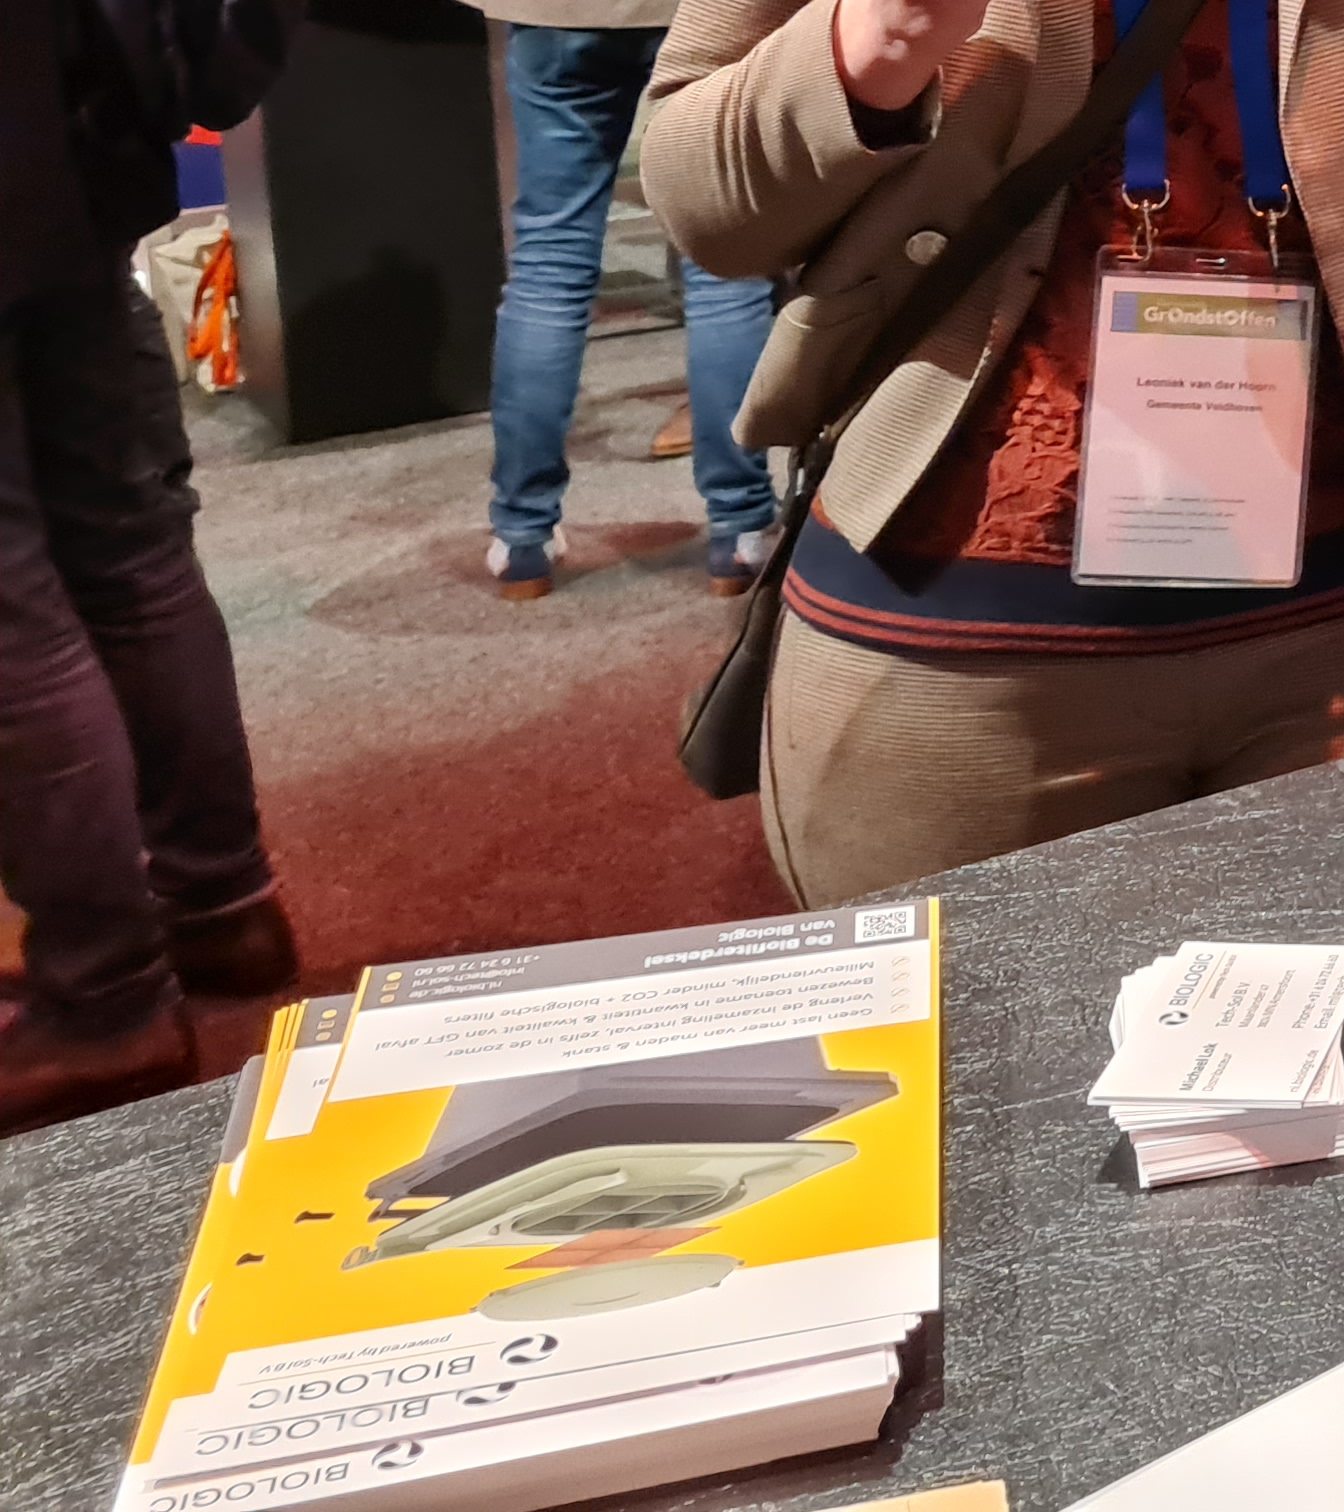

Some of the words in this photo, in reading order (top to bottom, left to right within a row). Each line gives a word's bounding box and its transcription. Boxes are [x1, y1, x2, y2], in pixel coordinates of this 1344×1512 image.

[1189, 380, 1212, 389] van
[1214, 379, 1236, 390] der
[800, 918, 836, 933] van
[717, 923, 795, 945] Biologic
[804, 933, 834, 947] De
[644, 938, 801, 968] Biofilterdeksel
[457, 961, 477, 972] 72
[479, 958, 499, 969] 24
[501, 957, 512, 968] 6
[662, 974, 727, 997] minder
[797, 975, 875, 993] Bewezen
[1167, 953, 1214, 1006] BIOLOGIC
[621, 990, 659, 1003] CO2
[715, 988, 793, 1004] toename
[808, 992, 874, 1009] Verleng
[499, 997, 600, 1019] biologische
[693, 999, 711, 1010] in
[782, 1002, 804, 1014] de
[444, 1010, 496, 1025] filters
[681, 1006, 777, 1027] inzameling
[792, 1014, 823, 1026] last
[828, 1007, 873, 1020] Geen
[502, 1016, 578, 1034] kwaliteit
[703, 1026, 736, 1038] van
[739, 1020, 787, 1034] meer
[424, 1032, 460, 1045] GFT
[465, 1027, 498, 1039] van
[559, 1030, 600, 1044] zelfs
[635, 1031, 698, 1048] maden
[374, 1037, 420, 1052] afval
[509, 1039, 532, 1051] de
[537, 1037, 554, 1047] in
[445, 1043, 504, 1057] zomer
[561, 1044, 612, 1058] stank
[1178, 1058, 1209, 1091] Michael
[1197, 1042, 1219, 1058] Lok
[376, 1332, 453, 1355] powered
[356, 1346, 378, 1357] by
[247, 1353, 477, 1410] BIOLOGIC
[194, 1397, 431, 1457] BIOLOGIC
[149, 1461, 351, 1512] BIOLOGIC
